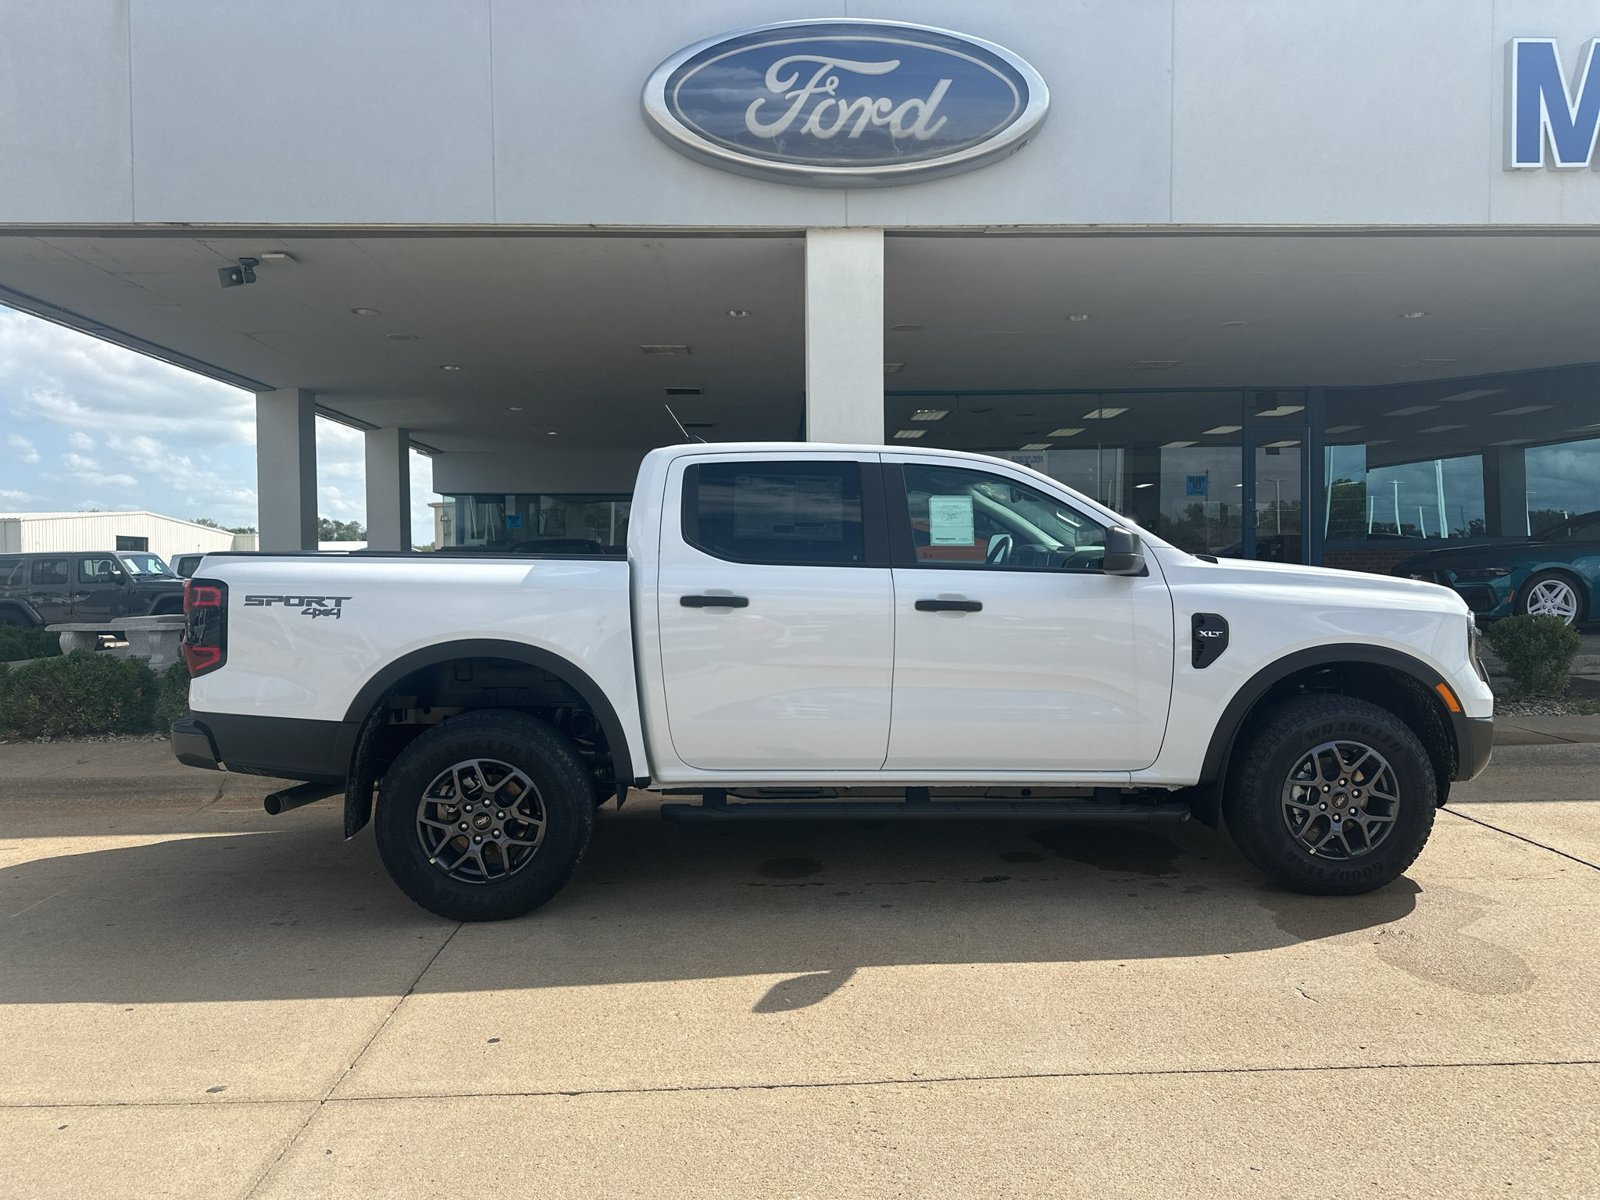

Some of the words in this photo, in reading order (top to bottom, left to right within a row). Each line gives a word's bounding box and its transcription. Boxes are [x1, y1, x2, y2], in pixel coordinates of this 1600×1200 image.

[745, 54, 953, 140] Ford
[1505, 37, 1600, 170] M
[244, 594, 353, 607] SPORT
[1199, 630, 1224, 638] XLT
